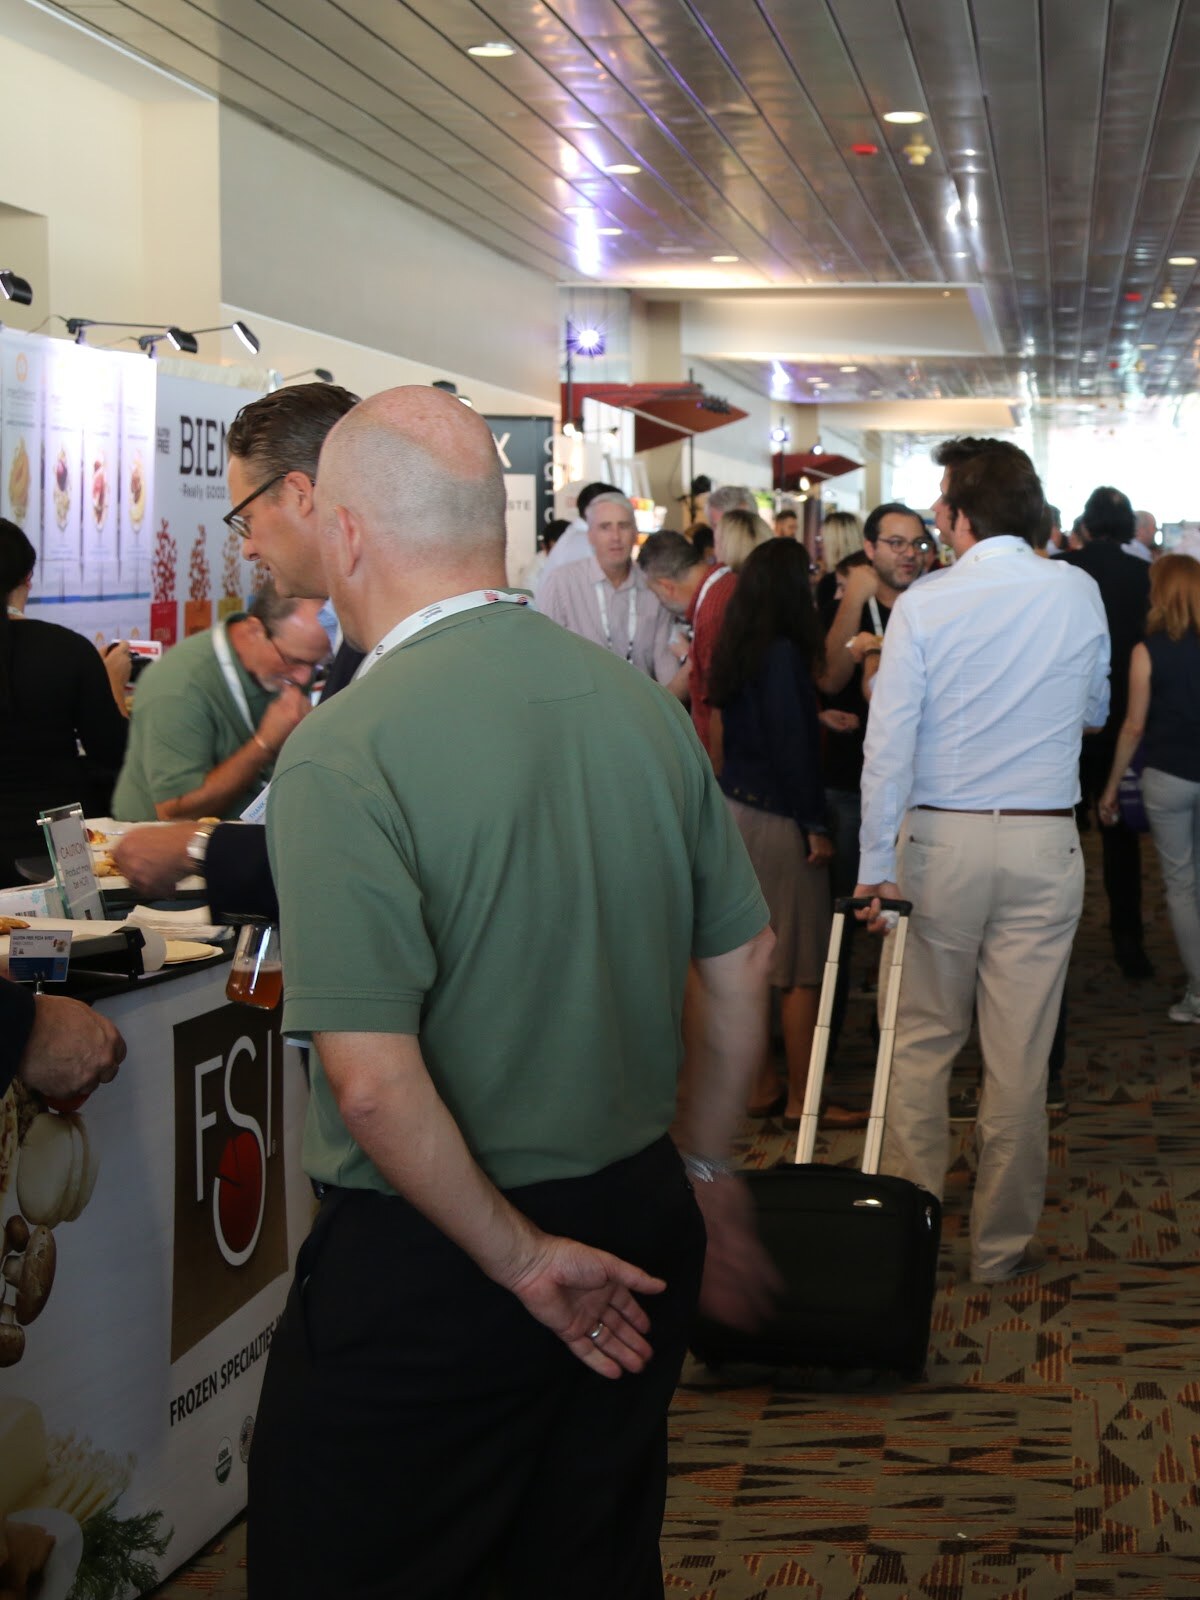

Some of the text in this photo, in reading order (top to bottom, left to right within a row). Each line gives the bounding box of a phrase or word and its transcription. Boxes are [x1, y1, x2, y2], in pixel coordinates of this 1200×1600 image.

[61, 842, 85, 859] CAUTION
[195, 1029, 272, 1266] FSI
[170, 1372, 217, 1426] FROZEN
